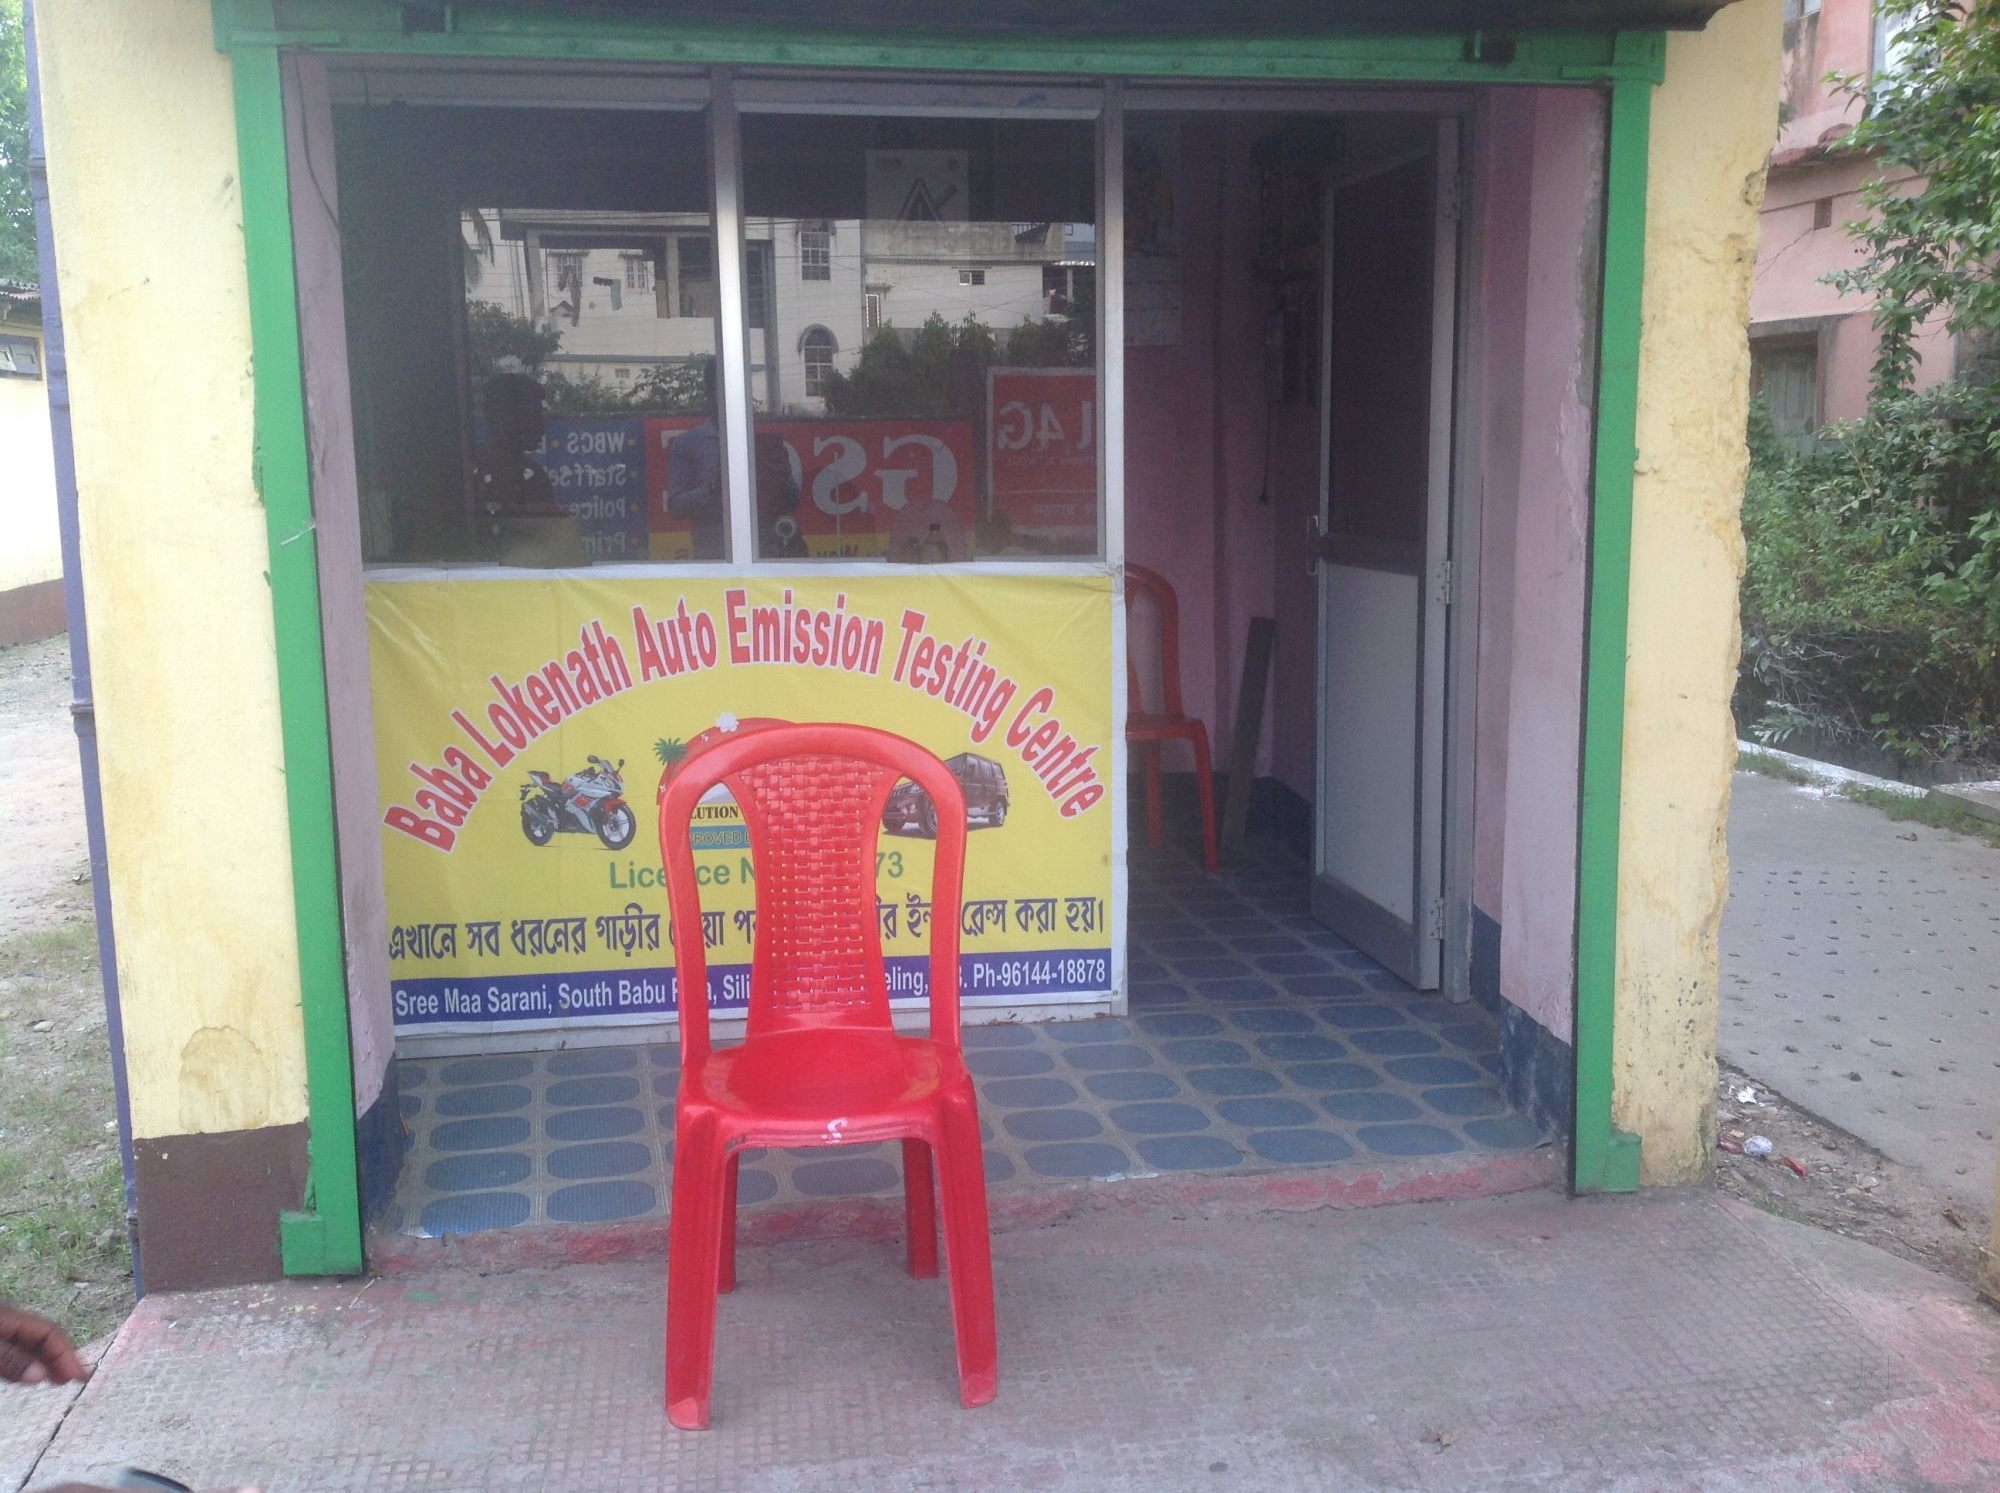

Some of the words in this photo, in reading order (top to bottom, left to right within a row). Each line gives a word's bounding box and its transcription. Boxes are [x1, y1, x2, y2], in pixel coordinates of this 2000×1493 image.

[383, 745, 493, 852] Baba
[450, 619, 633, 769] Lokenath
[632, 597, 717, 682] Auto
[725, 588, 885, 676] Emission
[893, 609, 1017, 743] Testing
[1005, 687, 1105, 818] Centre
[690, 805, 739, 820] LUTION
[690, 831, 742, 845] ROVED
[609, 860, 731, 890] Licece
[388, 922, 458, 960] এখানে
[464, 920, 501, 957] সব
[510, 916, 587, 955] ধরনের
[1014, 897, 1058, 934] করা
[395, 988, 439, 1017] Sree
[443, 987, 482, 1014] Maa
[486, 984, 553, 1014] Sarani,
[558, 982, 613, 1010] South
[618, 978, 666, 1006] Babu
[885, 966, 929, 997] eling,
[973, 957, 1106, 988] Ph-96144-18878
